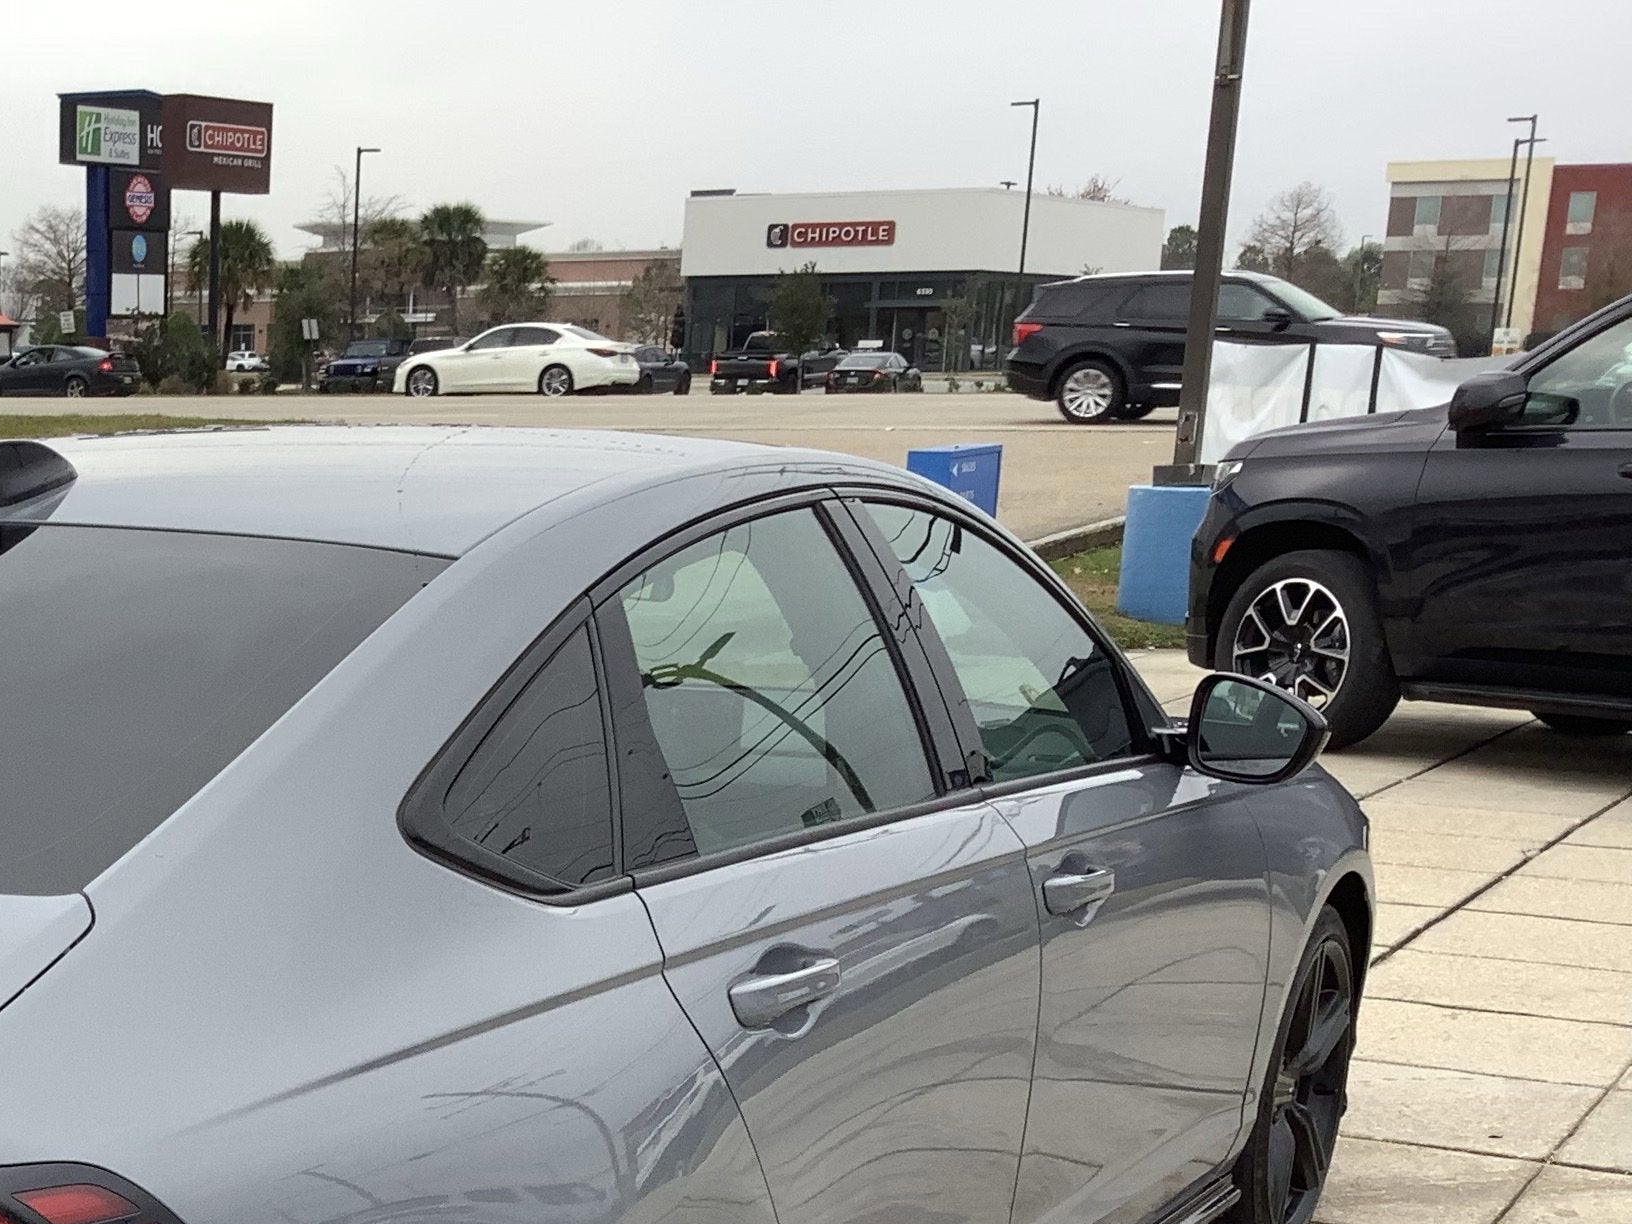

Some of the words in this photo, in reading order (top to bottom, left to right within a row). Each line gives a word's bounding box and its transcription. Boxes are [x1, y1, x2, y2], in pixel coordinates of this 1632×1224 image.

[103, 126, 137, 146] Express
[205, 131, 264, 150] CHIPOTLE
[114, 148, 131, 159] Suites
[213, 156, 242, 166] MEXICAN
[244, 158, 262, 168] GRILL
[793, 225, 890, 242] CHIPOTLE
